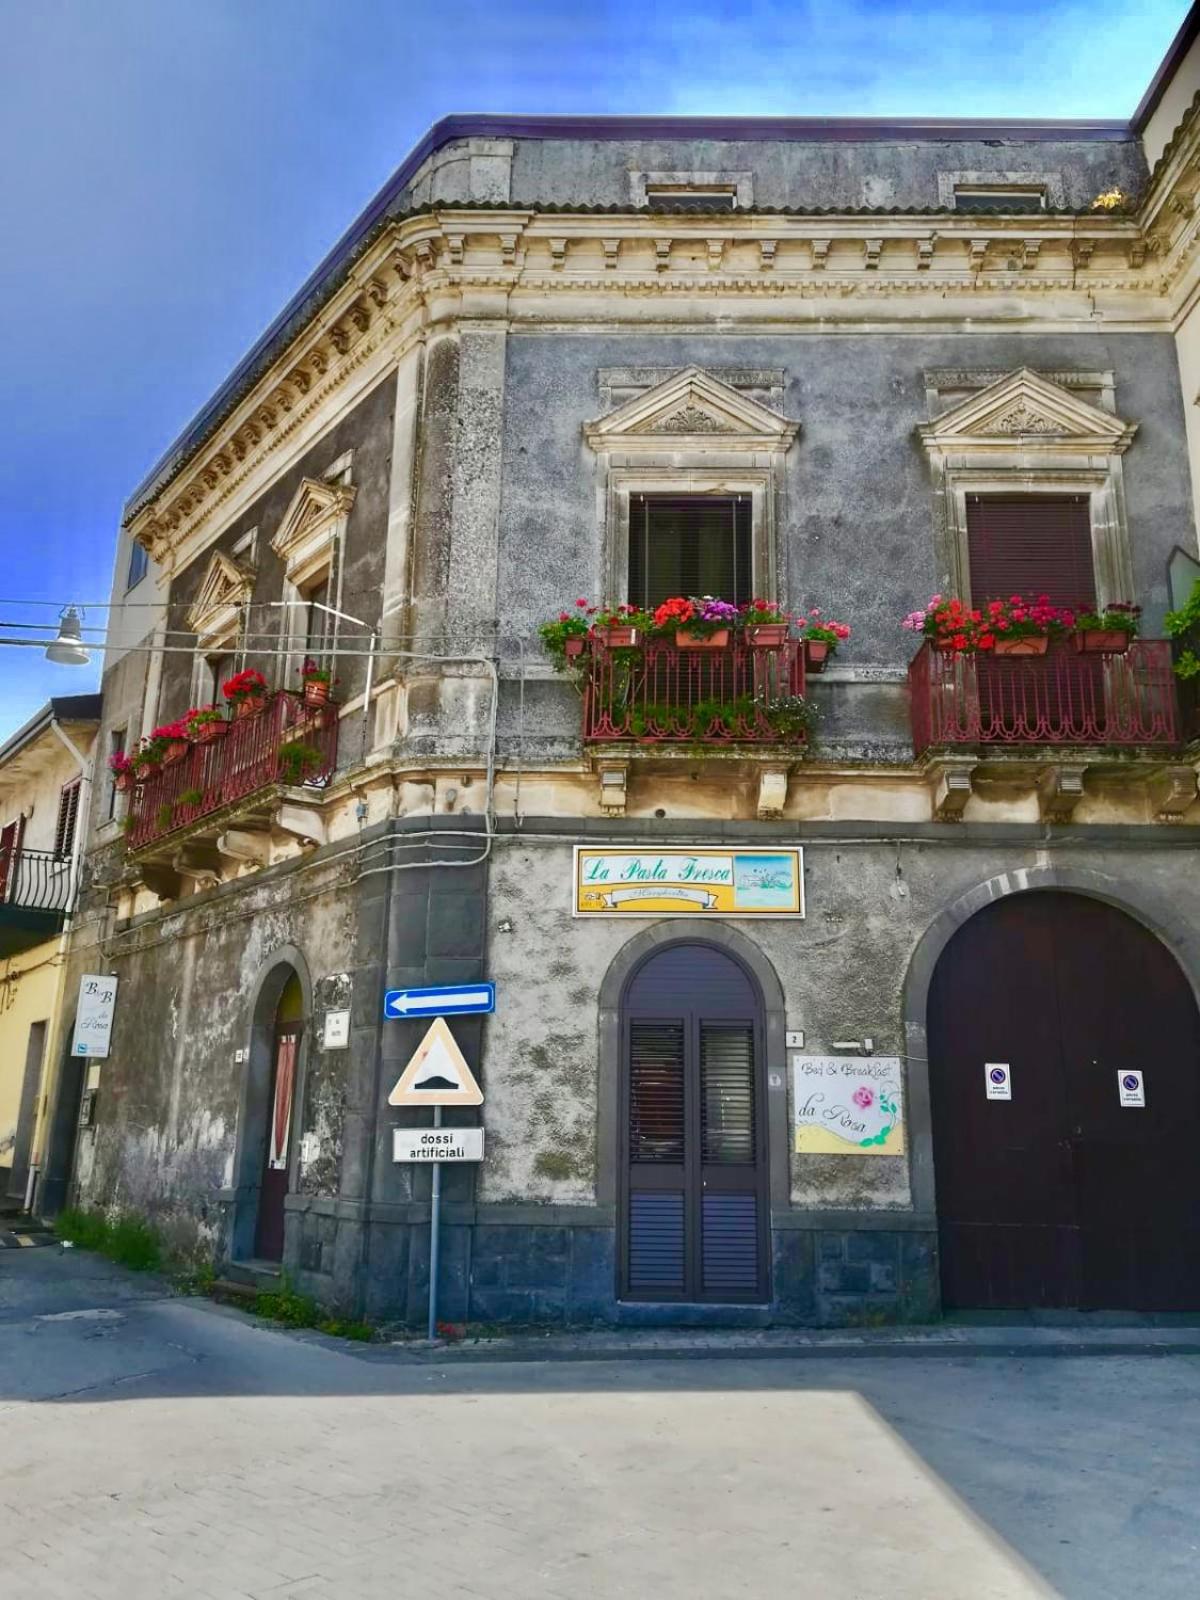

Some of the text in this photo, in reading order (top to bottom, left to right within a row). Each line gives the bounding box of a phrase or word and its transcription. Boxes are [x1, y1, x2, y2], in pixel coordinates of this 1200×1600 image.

[584, 857, 731, 882] La Pasta Fresca
[801, 1061, 892, 1080] Bed & Breakfast
[798, 1092, 867, 1133] da Rosa
[420, 1133, 454, 1144] dossi
[409, 1147, 465, 1158] artificiali
